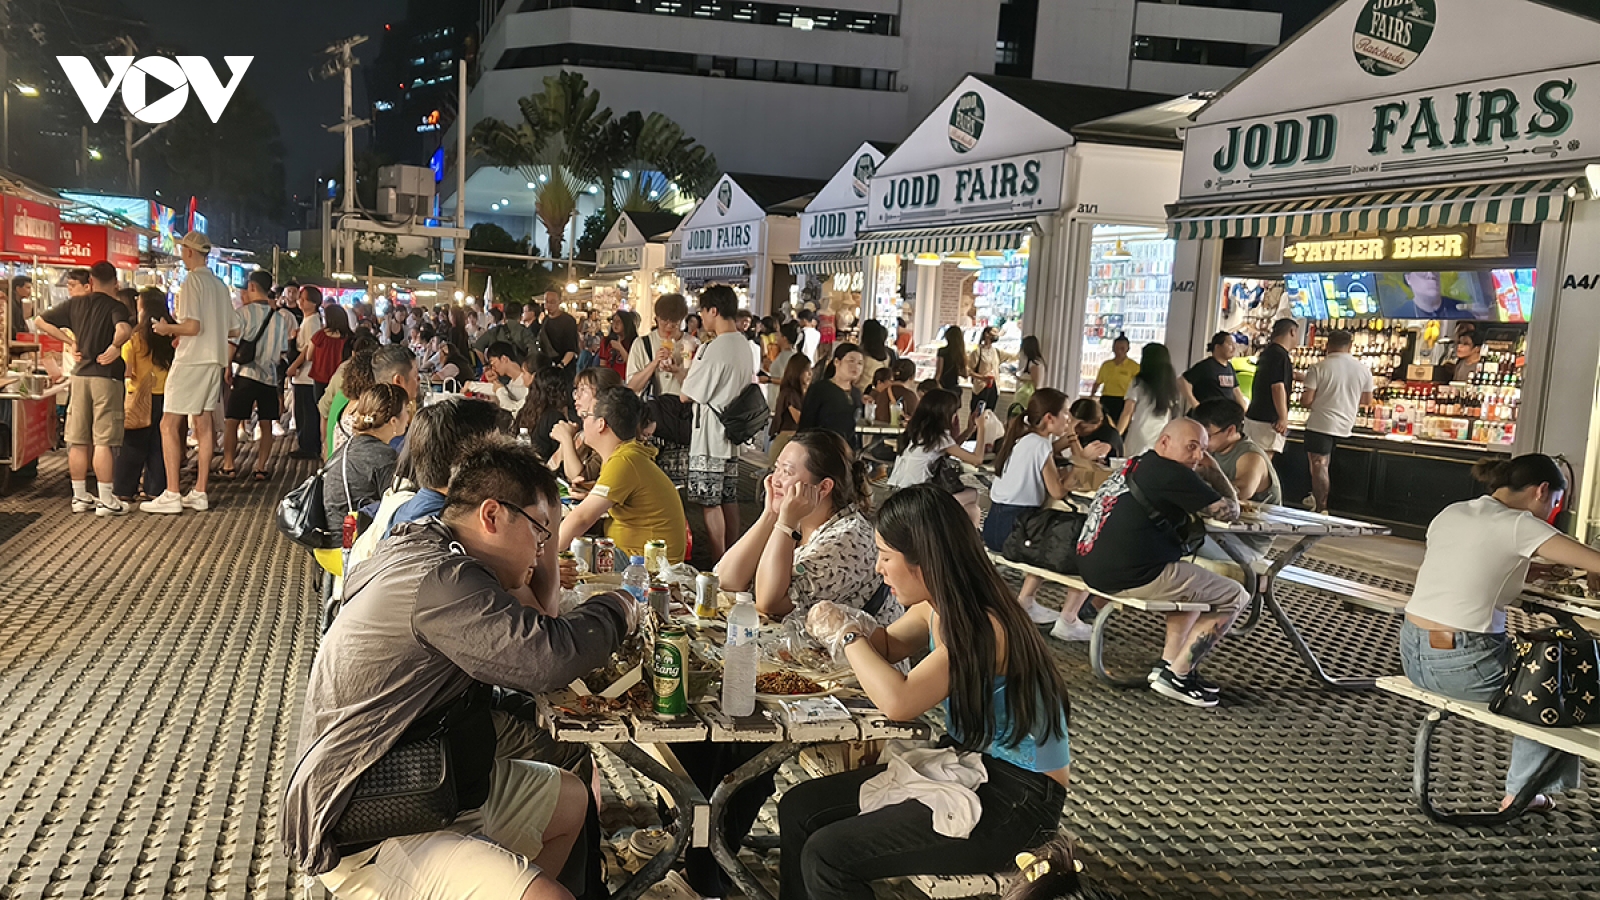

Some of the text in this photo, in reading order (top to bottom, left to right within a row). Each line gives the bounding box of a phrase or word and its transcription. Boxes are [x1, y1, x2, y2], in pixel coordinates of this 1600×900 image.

[1369, 10, 1413, 46] FAIRS
[1213, 78, 1577, 174] JODD FAIRS
[883, 173, 940, 209] JODD
[954, 160, 1041, 202] FAIRS
[687, 224, 751, 251] JODD FAIRS
[810, 211, 847, 239] JODD
[1294, 238, 1384, 263] FATHER
[1392, 234, 1463, 258] BEER
